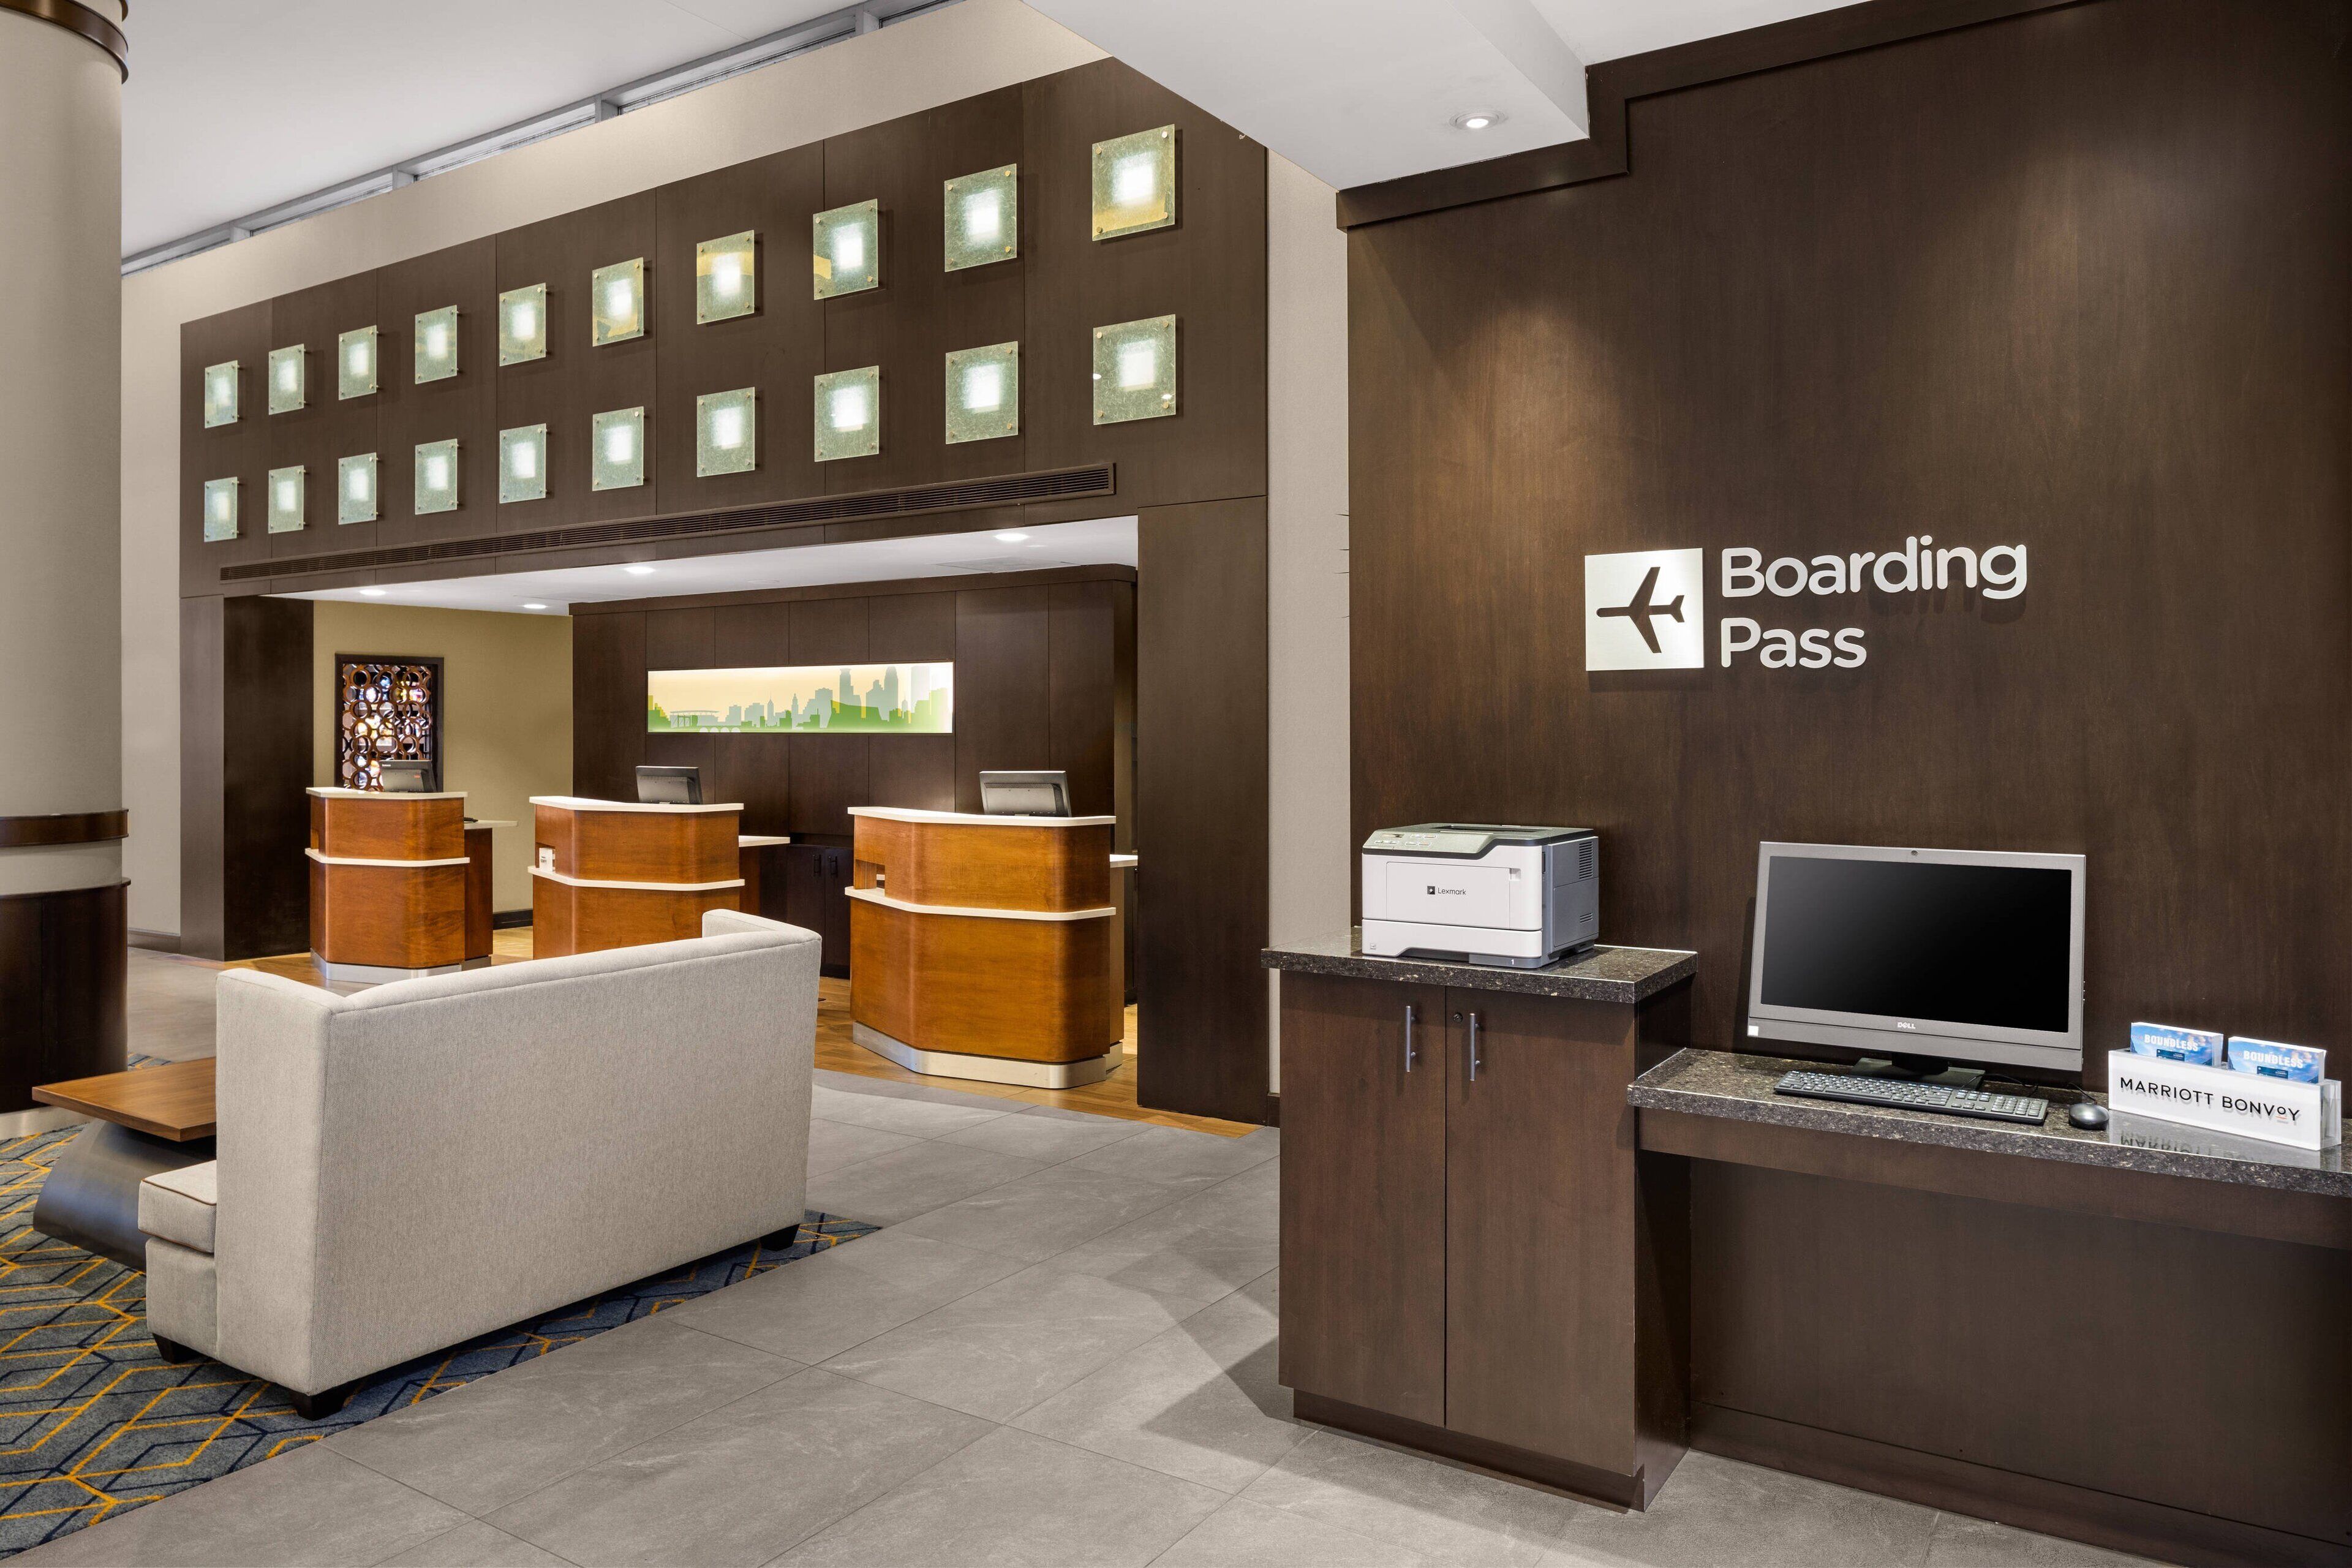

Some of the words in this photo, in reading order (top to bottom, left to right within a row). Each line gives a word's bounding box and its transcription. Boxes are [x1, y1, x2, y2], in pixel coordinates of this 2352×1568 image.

[1722, 535, 2027, 600] Boarding
[1721, 617, 1867, 668] Pass
[2144, 1034, 2198, 1052] BOUNDLESS
[2243, 1050, 2304, 1069] BOUNDLESS
[2120, 1077, 2214, 1105] MARRIOTT
